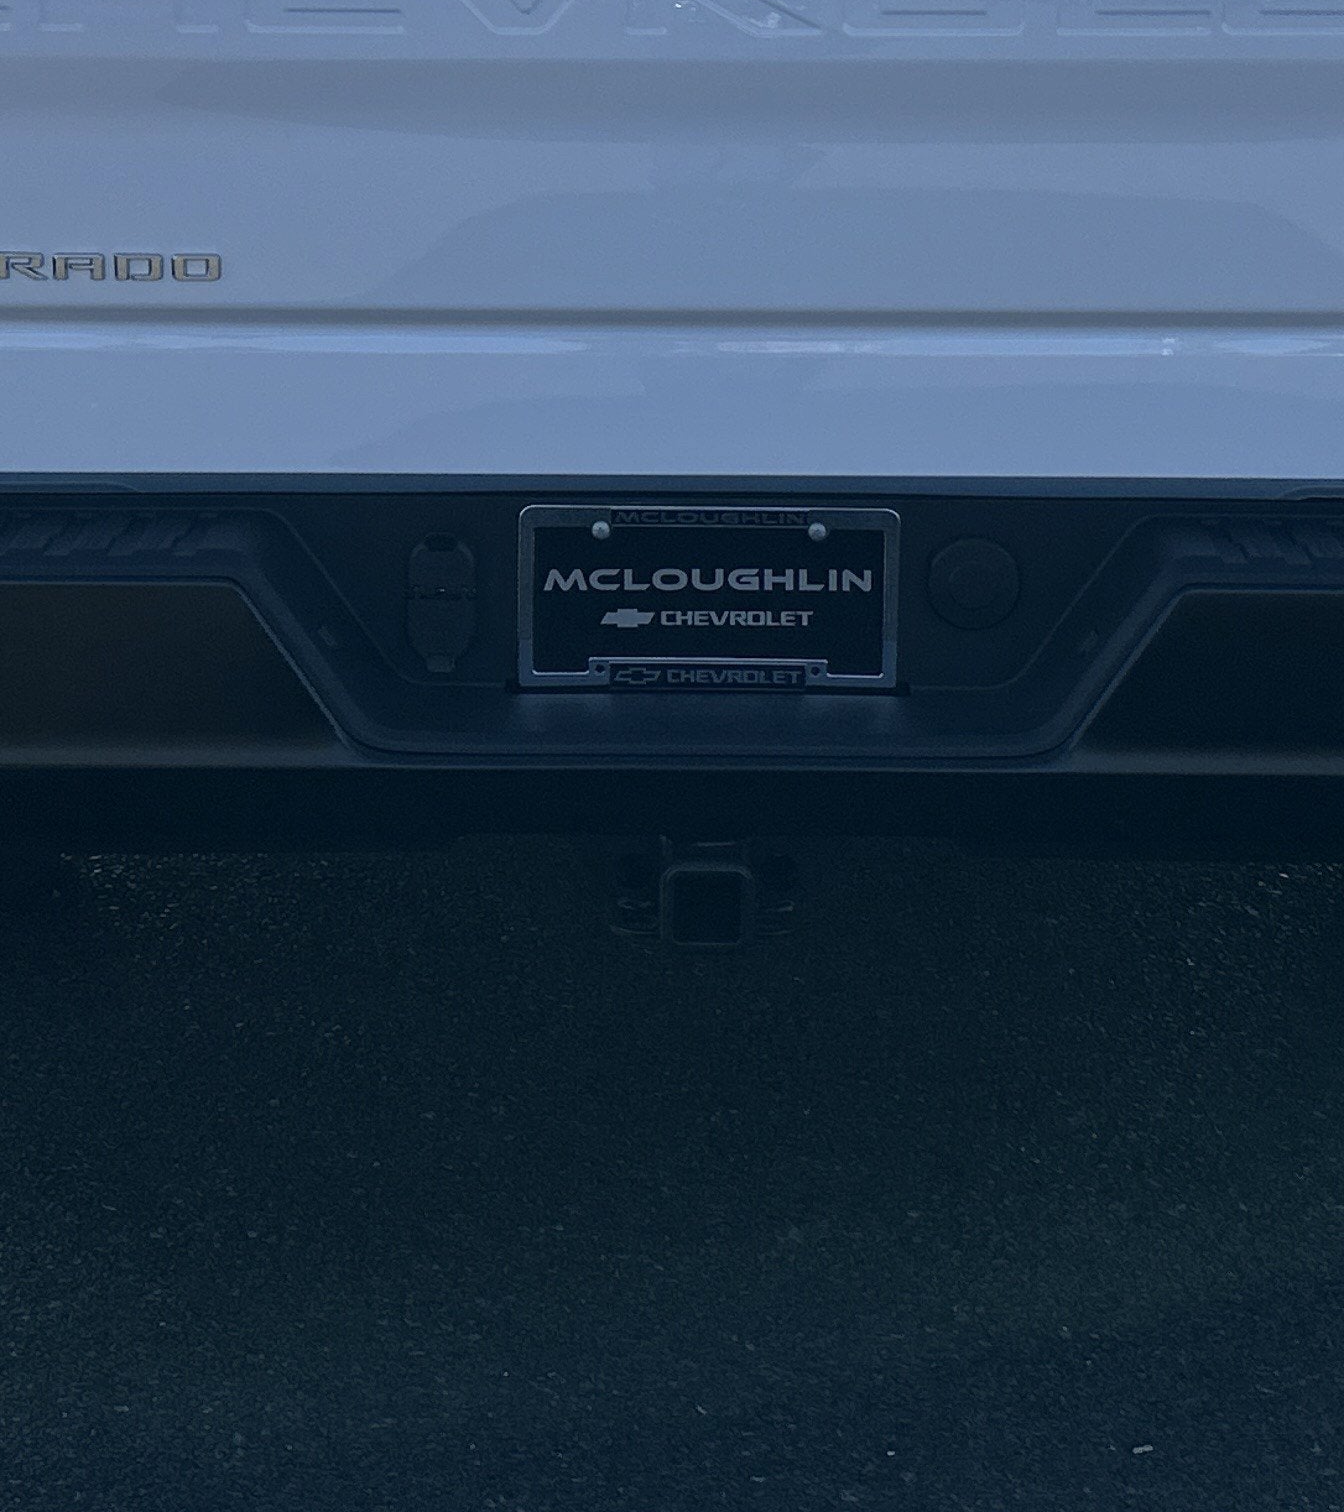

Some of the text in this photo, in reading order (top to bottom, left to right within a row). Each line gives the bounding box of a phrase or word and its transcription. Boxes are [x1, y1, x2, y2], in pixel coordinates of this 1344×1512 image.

[614, 511, 809, 525] MCLOUGHLIN
[544, 568, 872, 592] MCLOUGHLIN
[660, 610, 814, 627] CHEVROLET
[667, 670, 802, 685] CHEVROLET
